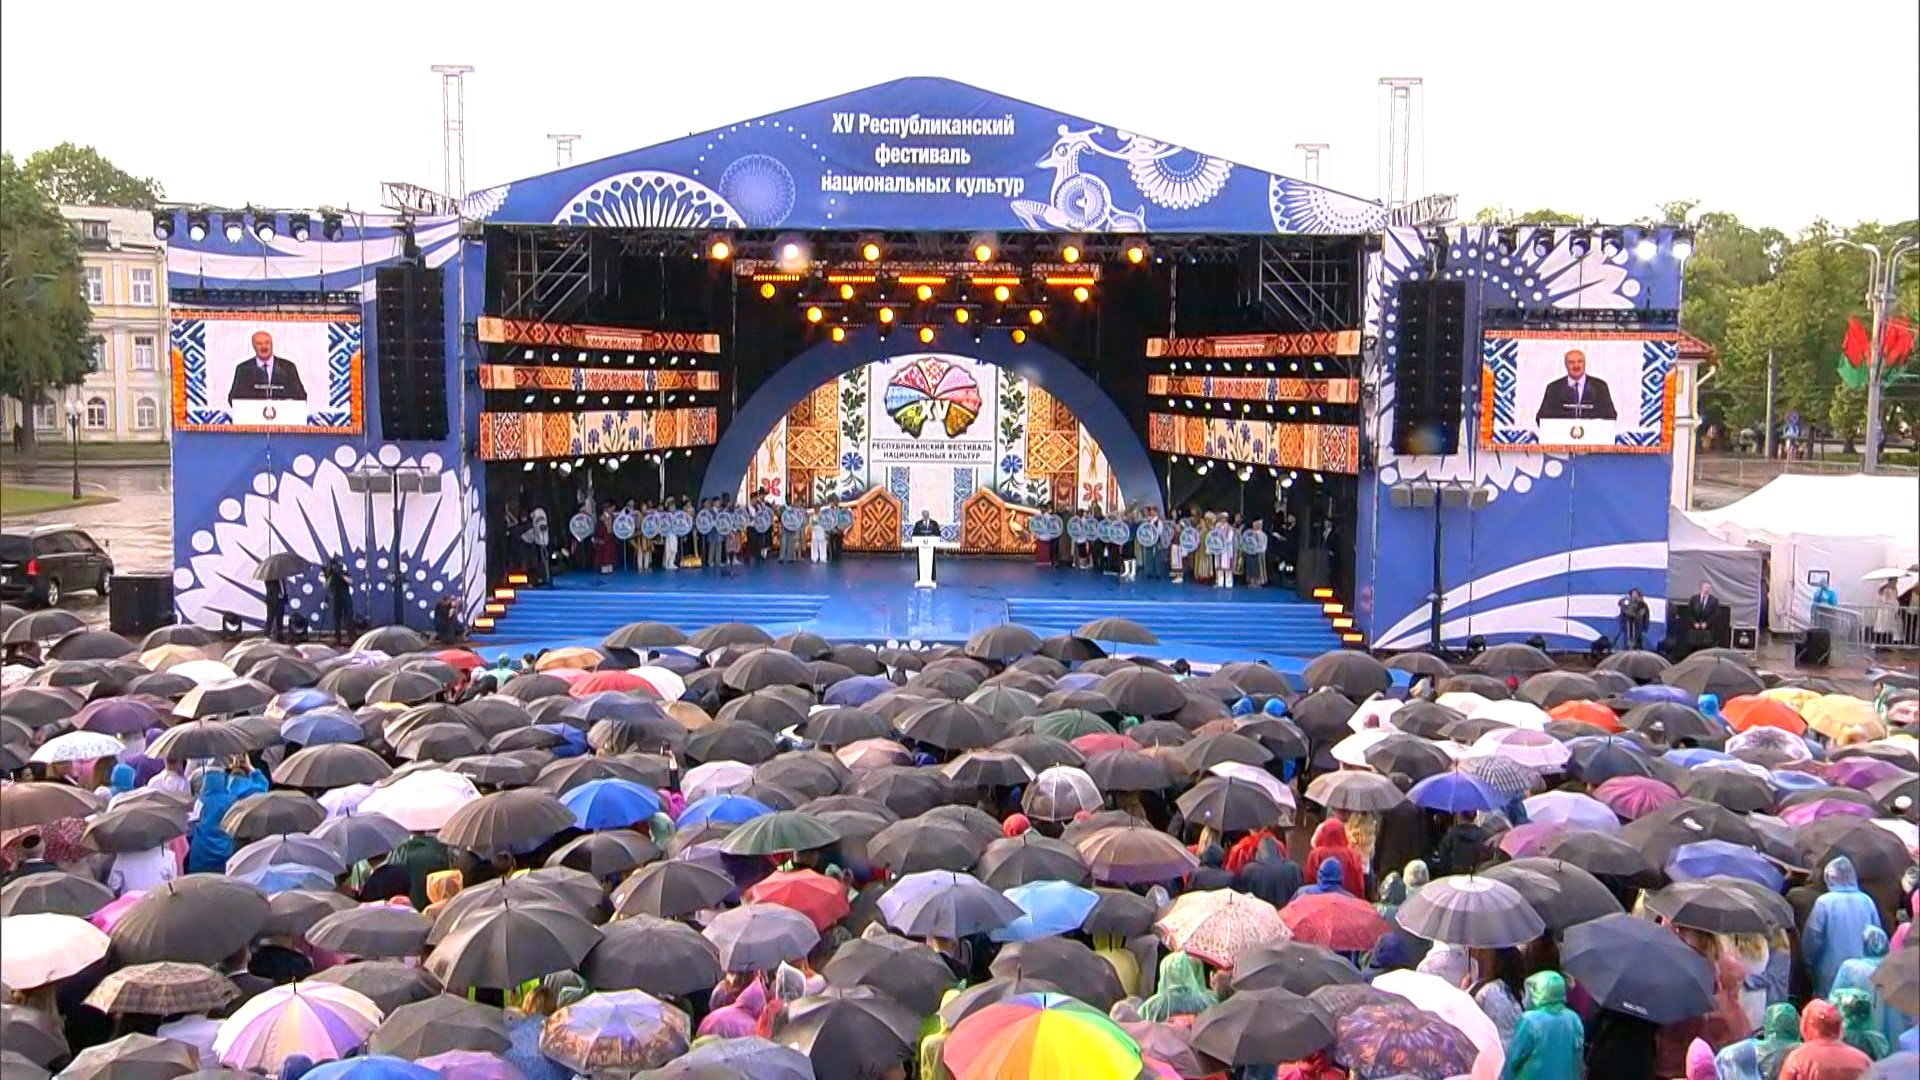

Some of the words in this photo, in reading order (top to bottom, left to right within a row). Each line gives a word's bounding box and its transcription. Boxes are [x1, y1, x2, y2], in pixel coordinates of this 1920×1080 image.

[832, 112, 854, 133] XV
[859, 113, 1015, 139] Республиканский
[875, 142, 971, 167] фестиваль
[821, 174, 951, 195] национальных
[955, 177, 1024, 197] культур
[919, 399, 950, 420] XV
[872, 442, 945, 451] РЕСПУБЛИКАНСКИЙ
[947, 443, 992, 451] ФЕСТИВАЛЬ
[883, 451, 946, 459] НАЦИОНАЛЬНЫХ
[948, 452, 981, 460] КУЛЬТУР
